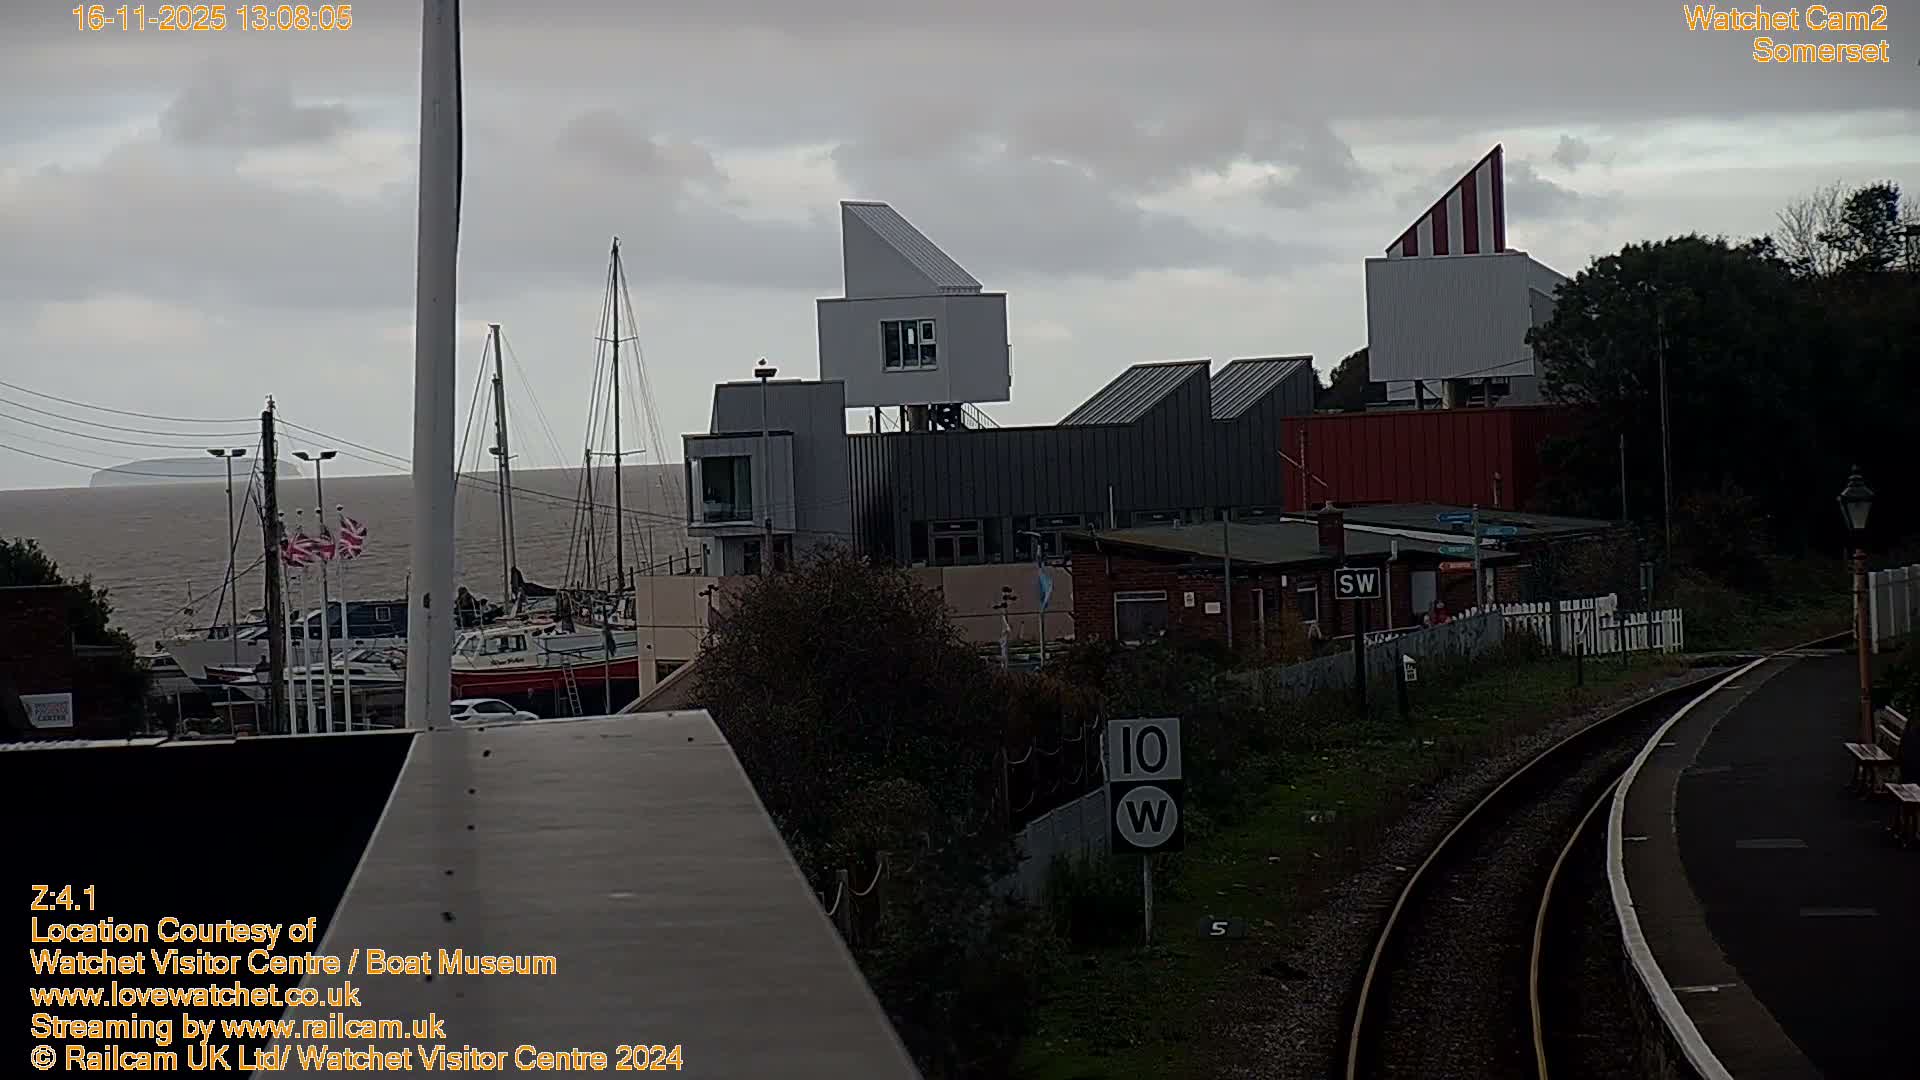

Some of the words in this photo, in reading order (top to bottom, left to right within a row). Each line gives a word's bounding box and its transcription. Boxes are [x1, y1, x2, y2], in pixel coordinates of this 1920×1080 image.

[1340, 573, 1374, 594] SW
[1121, 725, 1168, 774] 10
[1126, 799, 1168, 833] W
